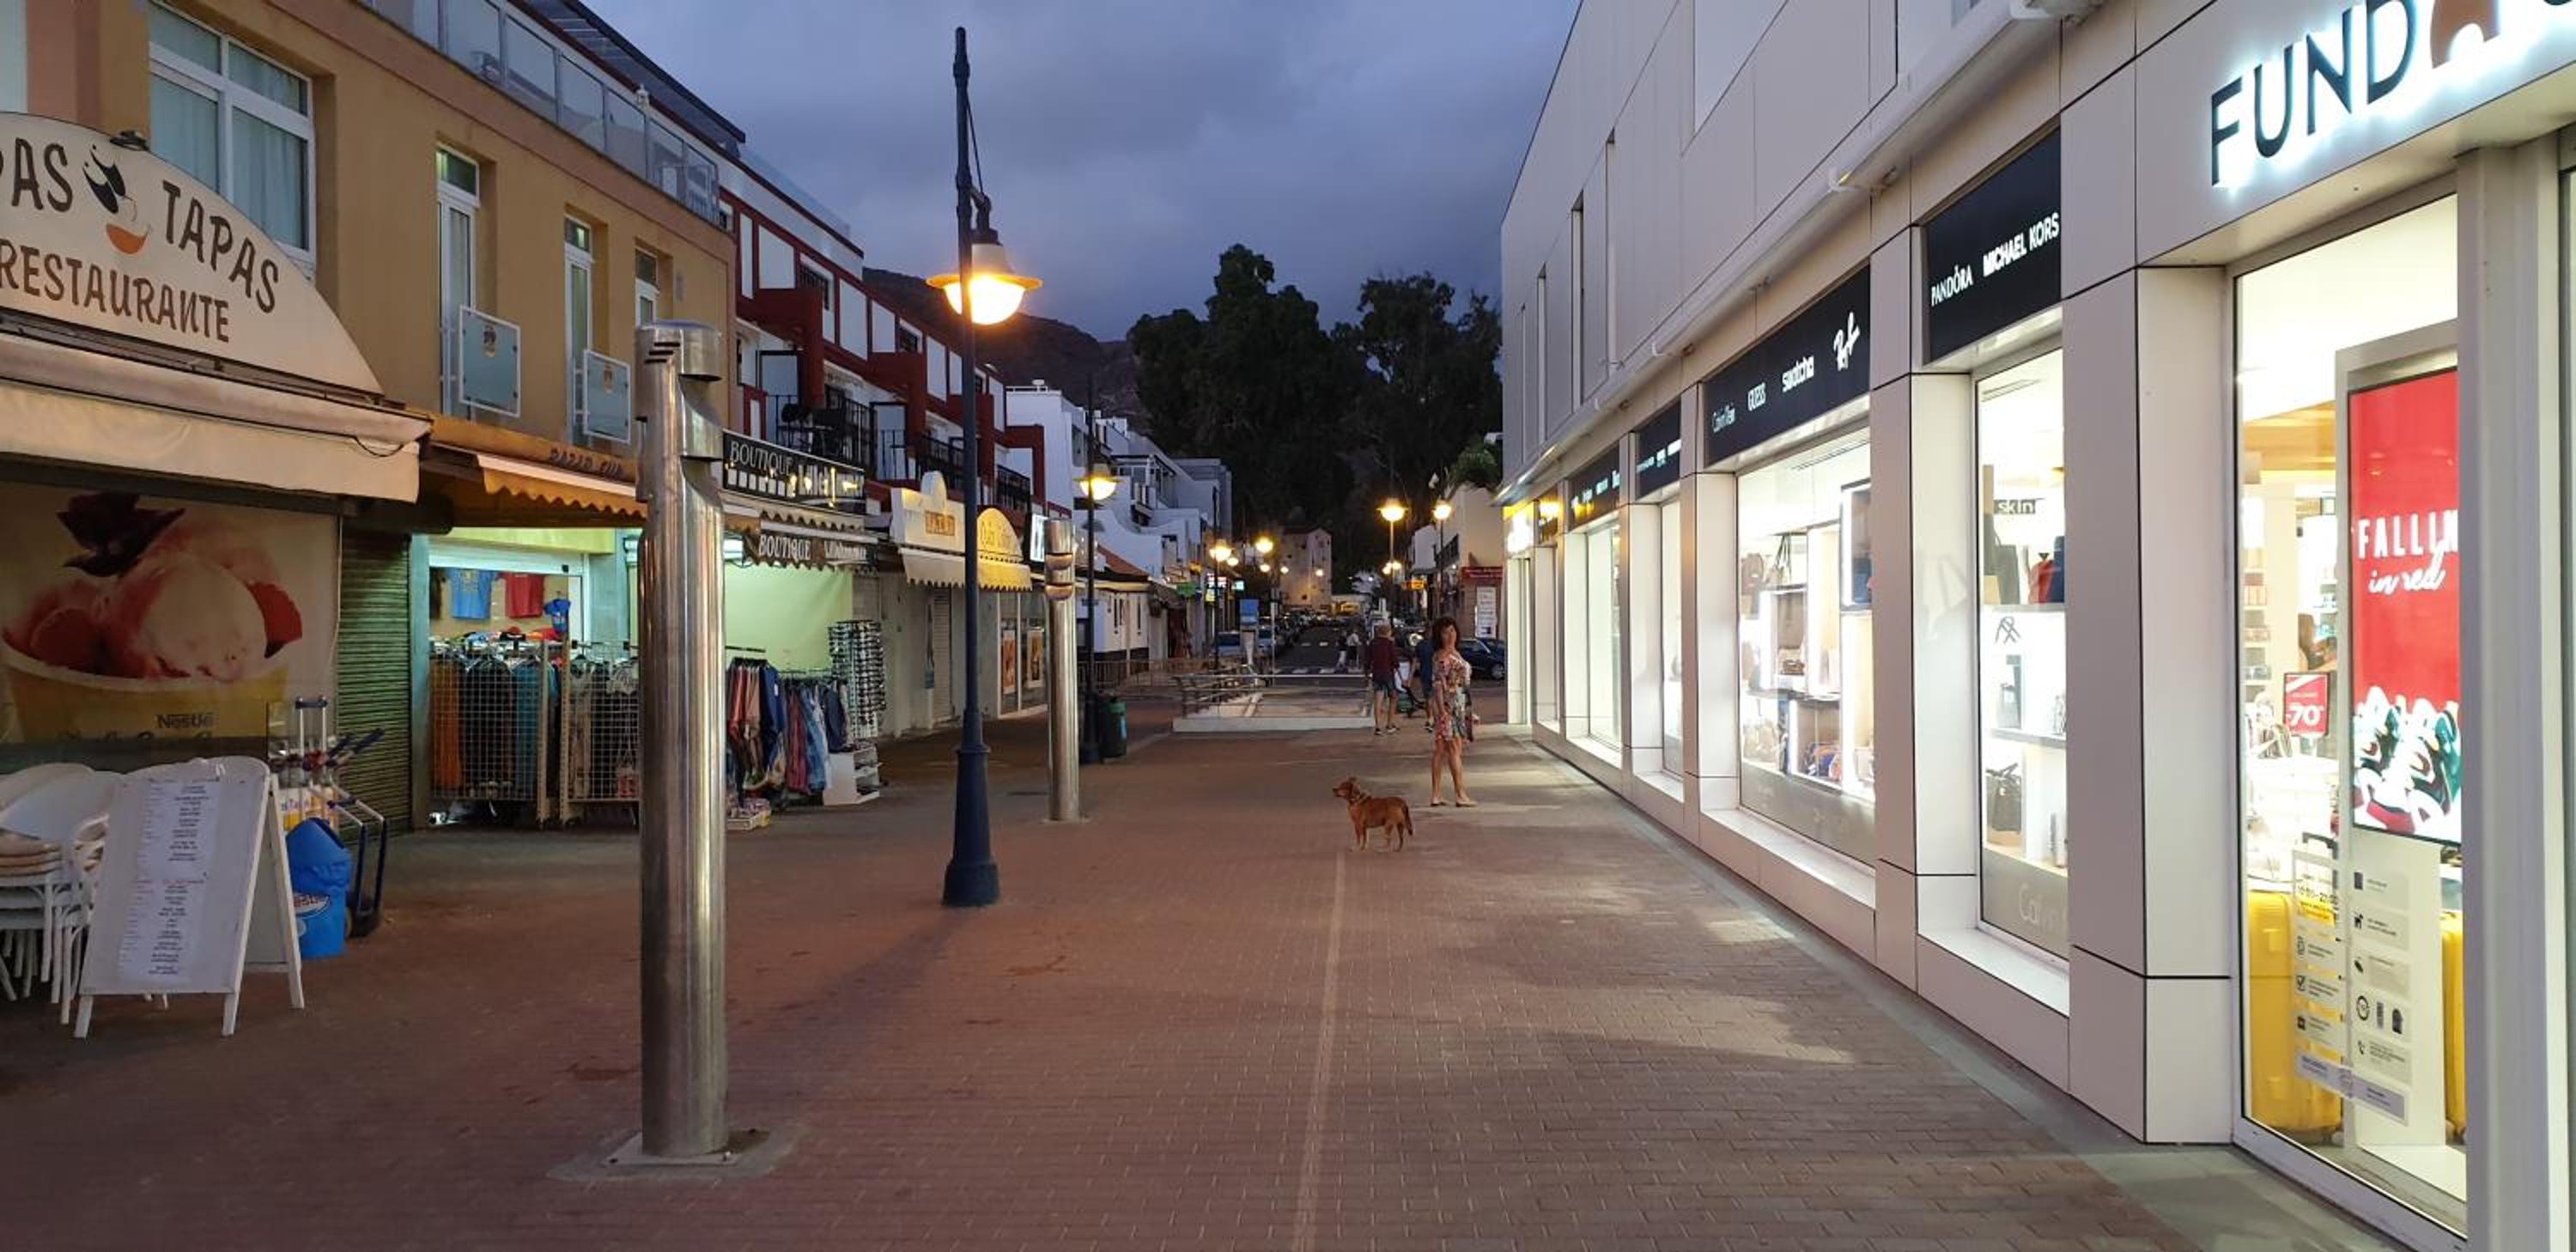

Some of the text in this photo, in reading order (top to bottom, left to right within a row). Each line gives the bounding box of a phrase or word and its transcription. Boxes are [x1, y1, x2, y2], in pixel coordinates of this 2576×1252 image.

[0, 137, 279, 313] AS TAPAS
[1983, 212, 2060, 277] MICHAEL KORS
[0, 238, 229, 343] RESTAURANTE
[1747, 382, 1766, 411] GUESS
[730, 441, 793, 477] BOUTIQUE
[758, 534, 811, 561] BOUTIQUE
[2368, 538, 2446, 595] in red
